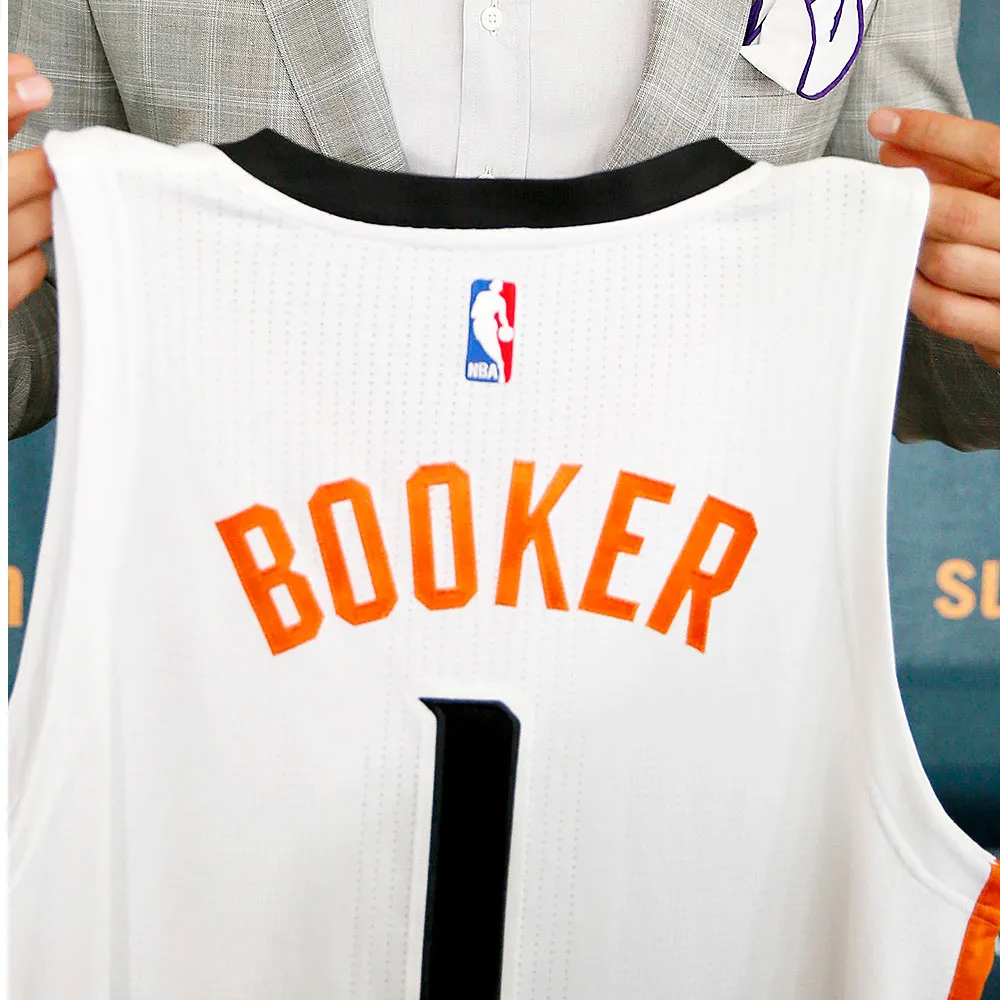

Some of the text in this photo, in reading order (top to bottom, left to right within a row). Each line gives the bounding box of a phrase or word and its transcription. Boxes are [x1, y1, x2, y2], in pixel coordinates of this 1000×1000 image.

[467, 361, 499, 380] NBA
[215, 459, 758, 655] BOOKER
[418, 697, 521, 1000] 1
